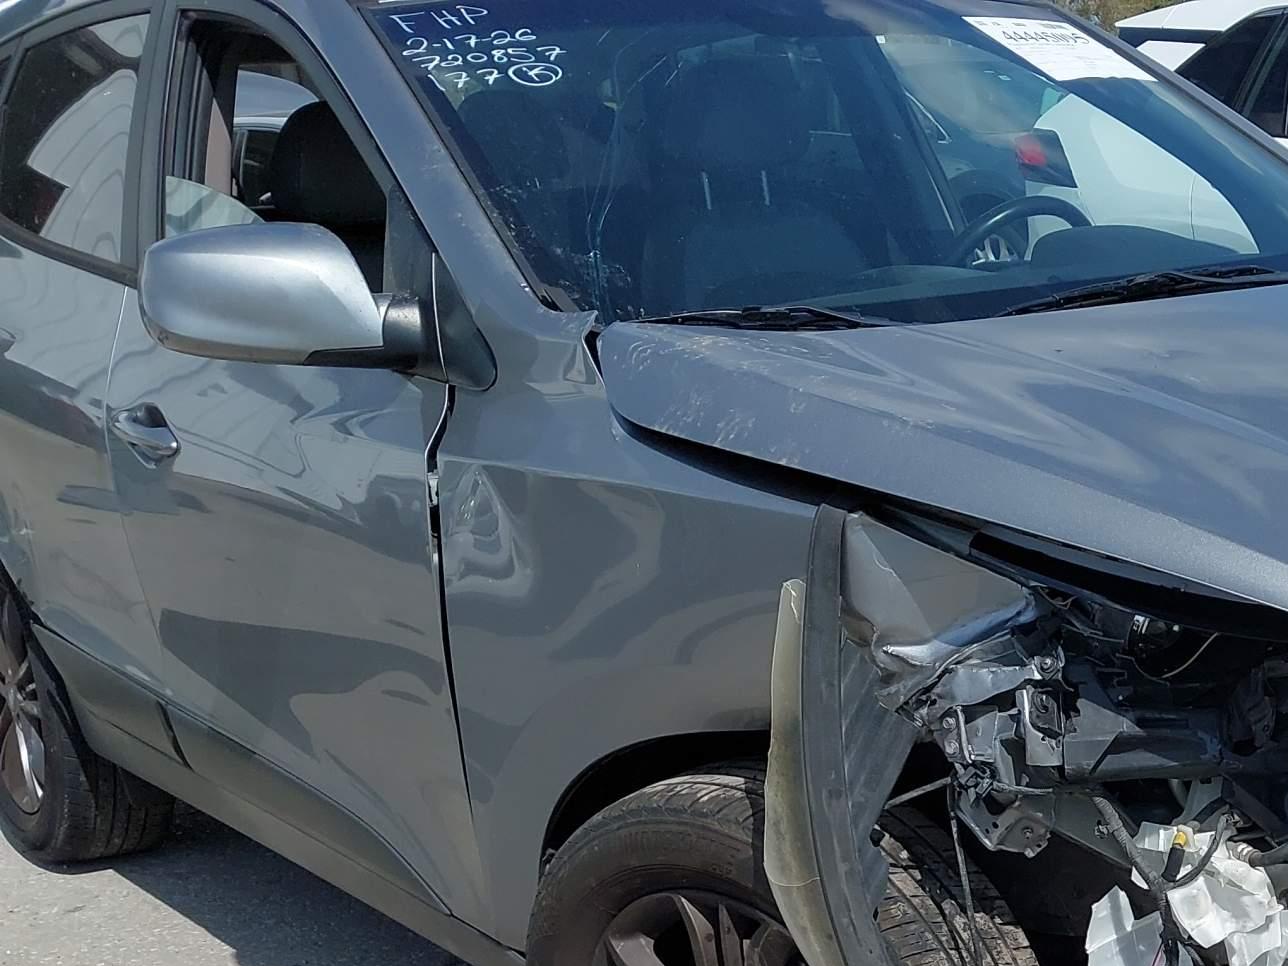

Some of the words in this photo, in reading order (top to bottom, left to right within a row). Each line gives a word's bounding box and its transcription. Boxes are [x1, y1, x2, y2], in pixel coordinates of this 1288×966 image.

[390, 5, 489, 33] FHP
[402, 28, 537, 56] 2-17-26
[412, 46, 567, 71] 720857
[427, 68, 504, 91] 177
